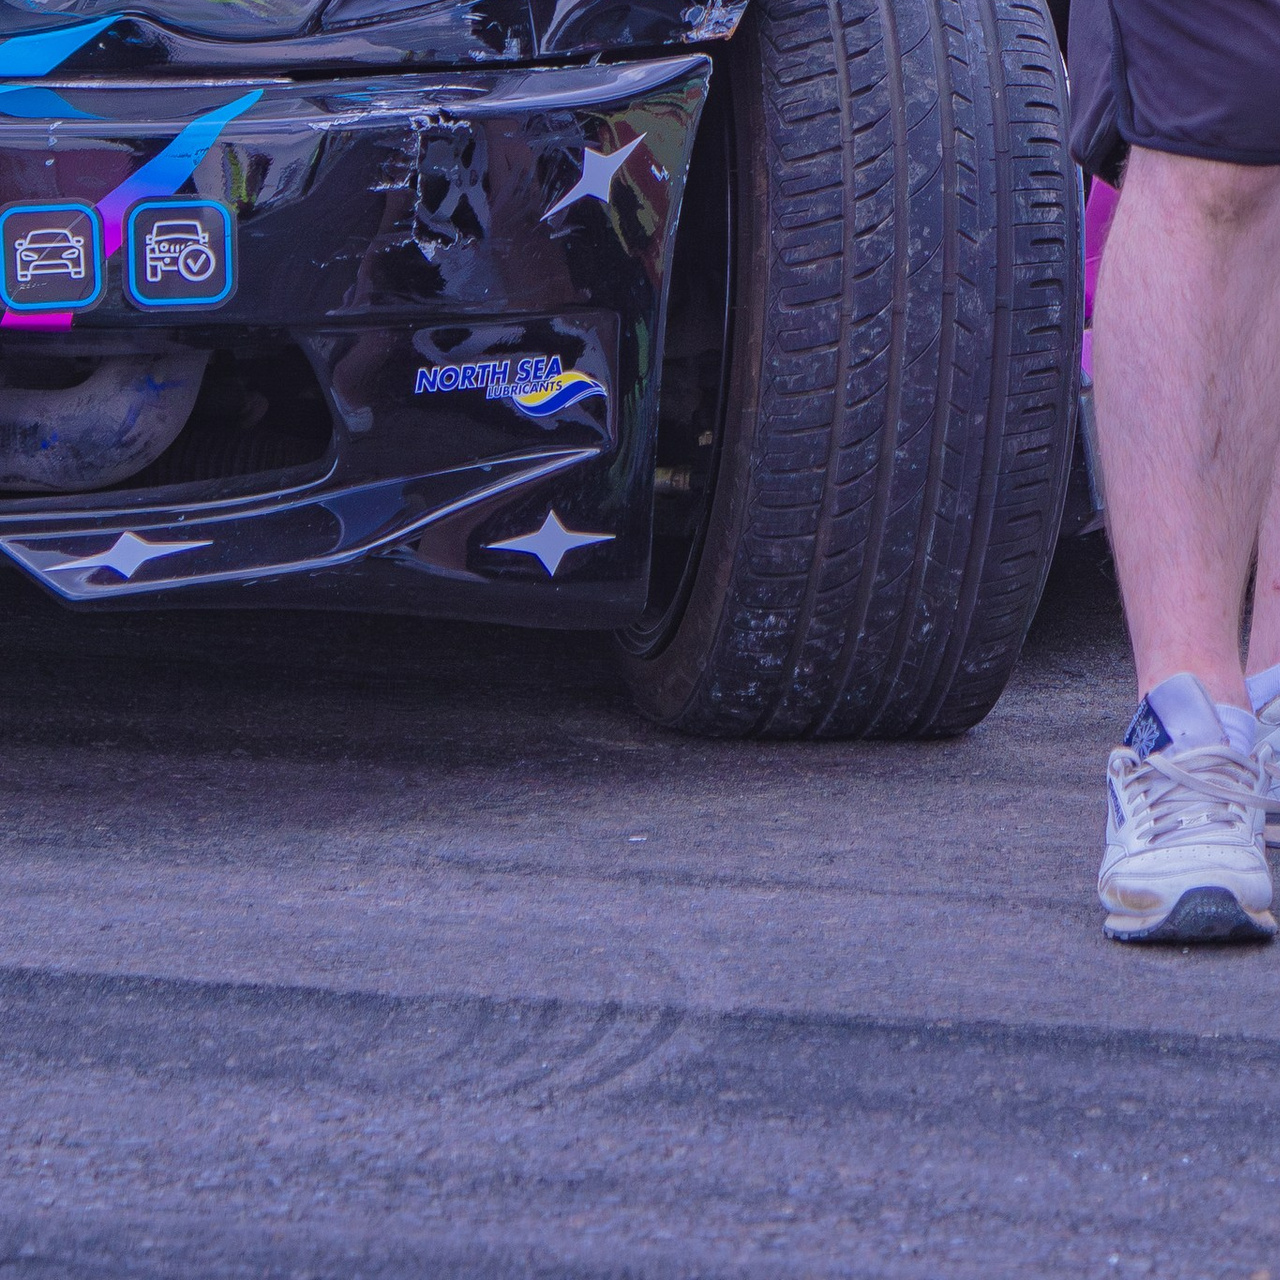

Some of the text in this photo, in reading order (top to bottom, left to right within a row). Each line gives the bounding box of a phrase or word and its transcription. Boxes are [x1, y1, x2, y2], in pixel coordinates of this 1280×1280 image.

[415, 354, 563, 394] NORTH SEA
[486, 380, 563, 400] LUBRICANTS
